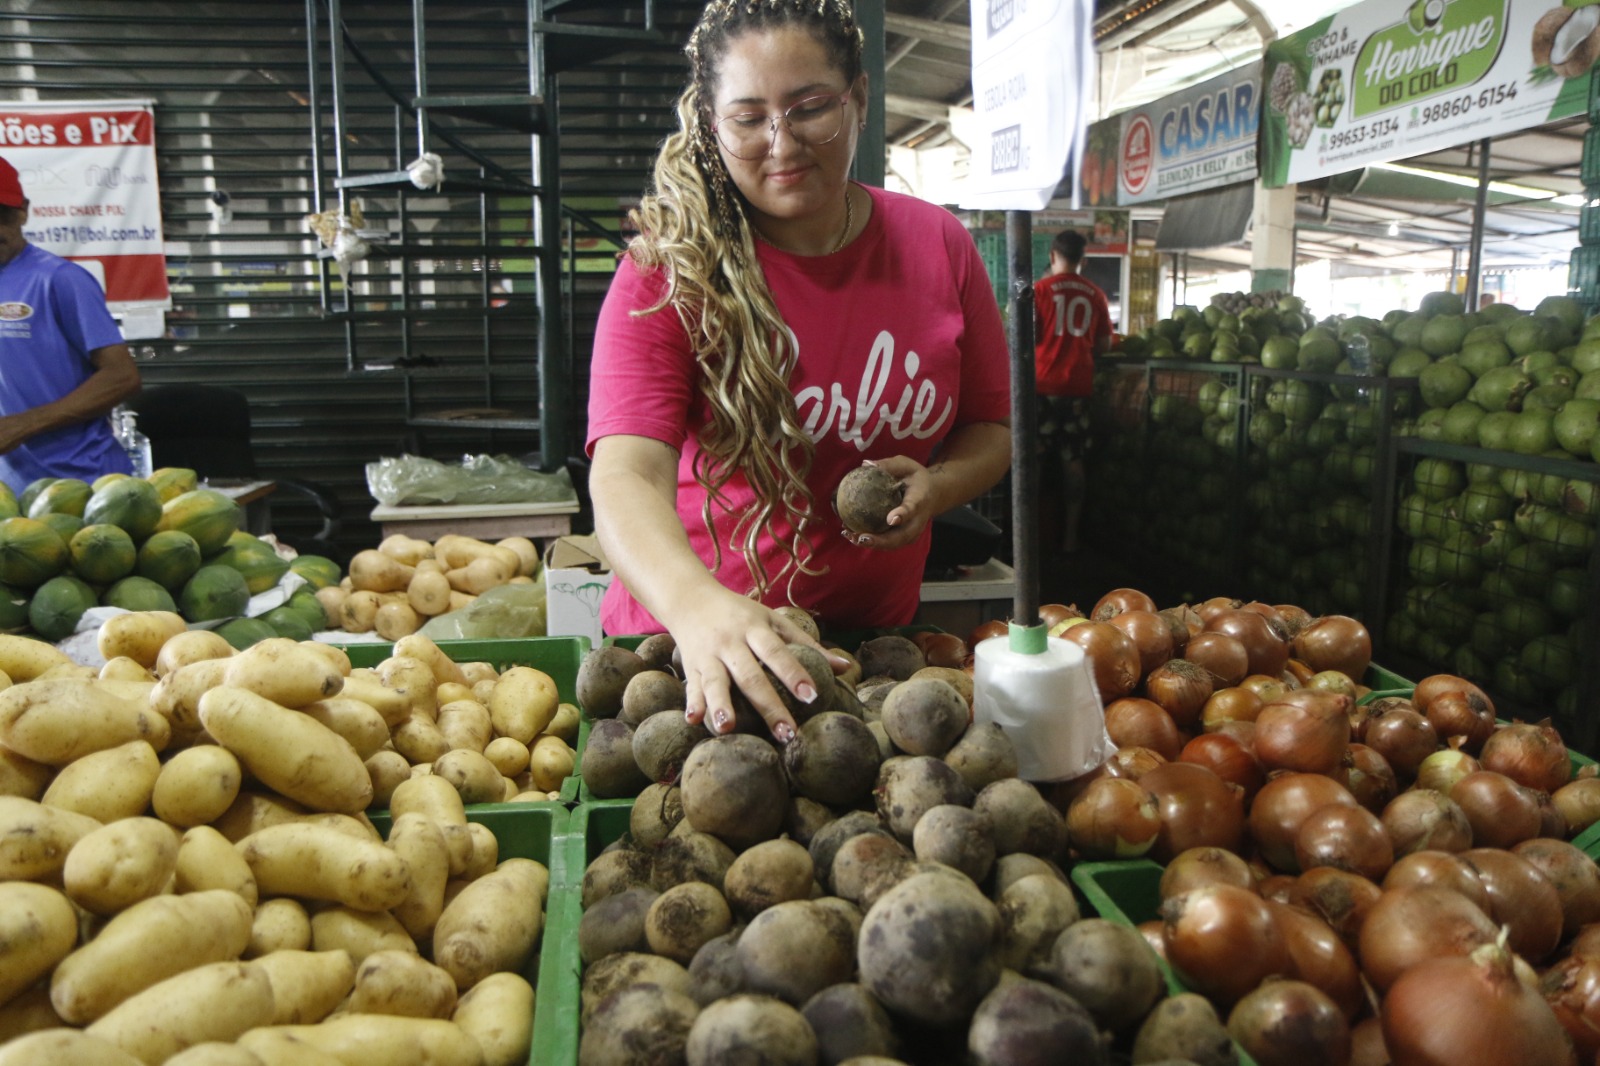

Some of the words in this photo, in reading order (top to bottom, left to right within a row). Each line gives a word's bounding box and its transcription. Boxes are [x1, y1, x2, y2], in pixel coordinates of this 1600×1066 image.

[1306, 31, 1338, 57] COCO
[1340, 27, 1348, 41] &
[1312, 40, 1358, 68] INHAME
[1363, 16, 1495, 88] Henrique
[1379, 81, 1402, 106] DO
[1408, 62, 1458, 96] COCO
[1422, 80, 1518, 126] 98860-6154
[64, 124, 82, 145] e
[89, 117, 139, 143] Pix
[1329, 116, 1400, 150] 99653-5134
[1203, 157, 1228, 174] KELLY
[33, 205, 66, 217] NOSSA
[70, 205, 103, 217] CHAVE
[1053, 294, 1092, 337] 10
[773, 325, 952, 452] arbie
